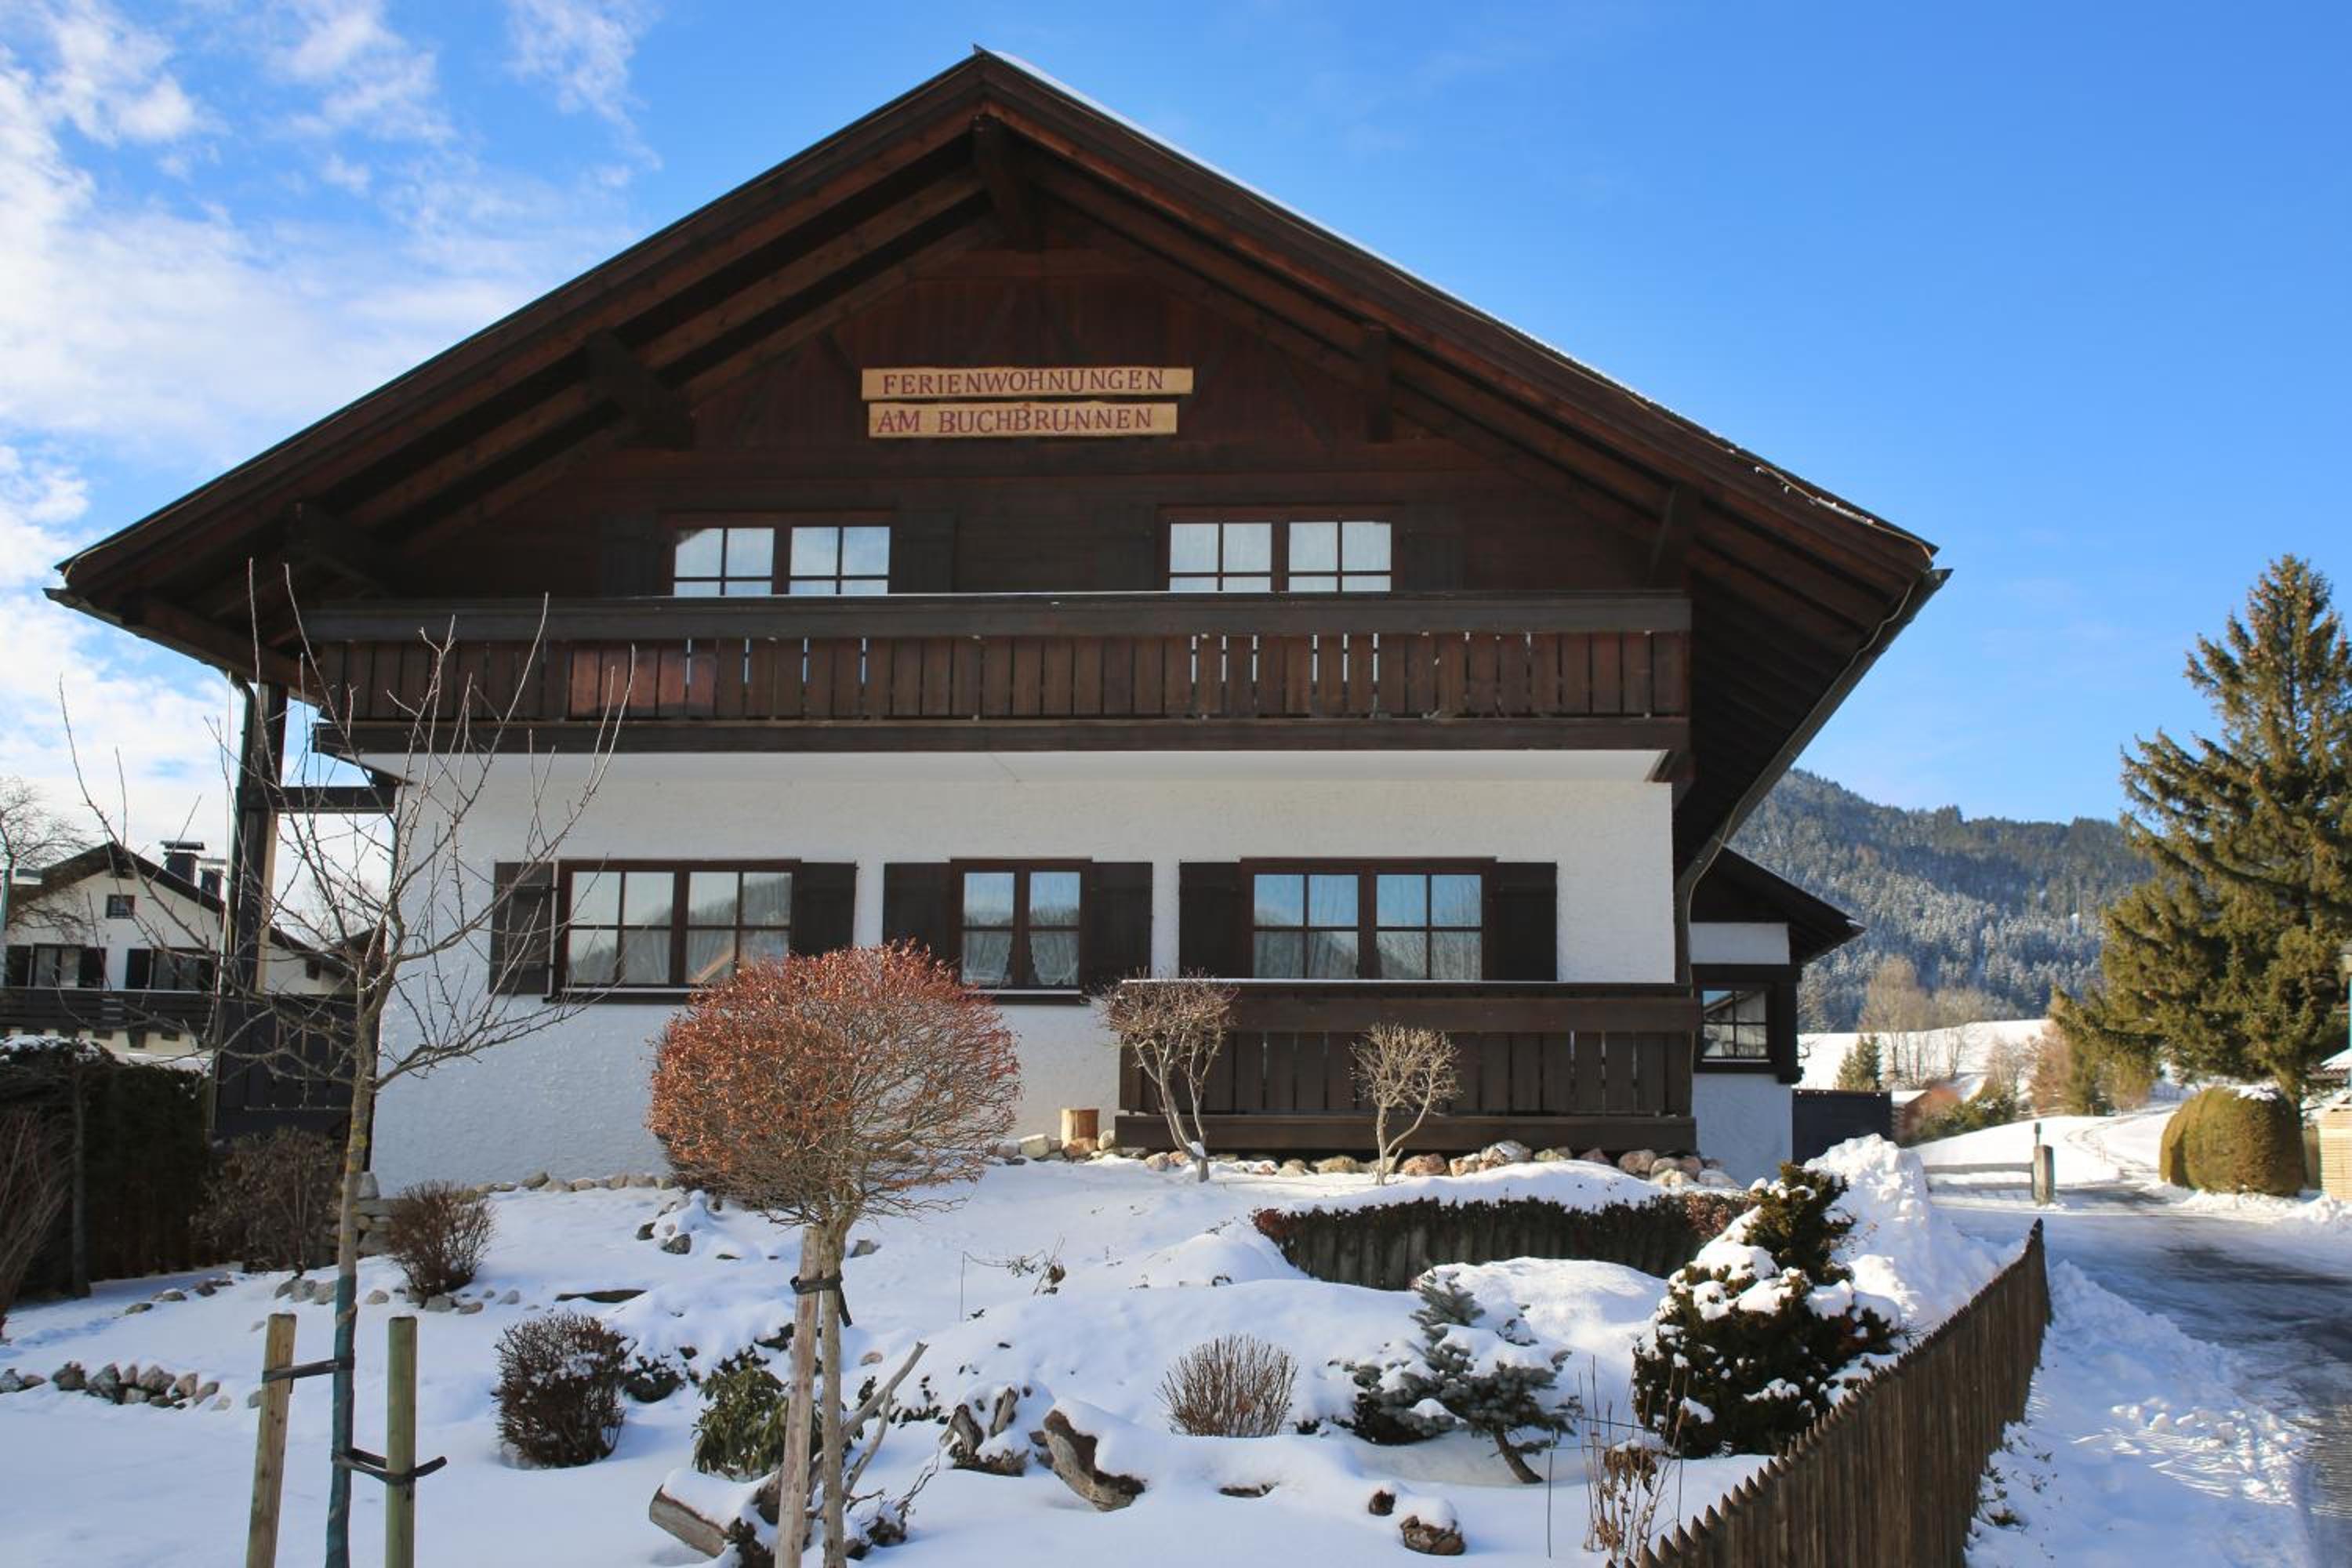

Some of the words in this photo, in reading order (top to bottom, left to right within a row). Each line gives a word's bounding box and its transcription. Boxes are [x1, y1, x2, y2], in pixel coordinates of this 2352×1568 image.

[883, 369, 1164, 394] FERIENWOHNUNGEN
[877, 409, 920, 433] AM
[938, 406, 1152, 434] BUCHBRUNNEN
